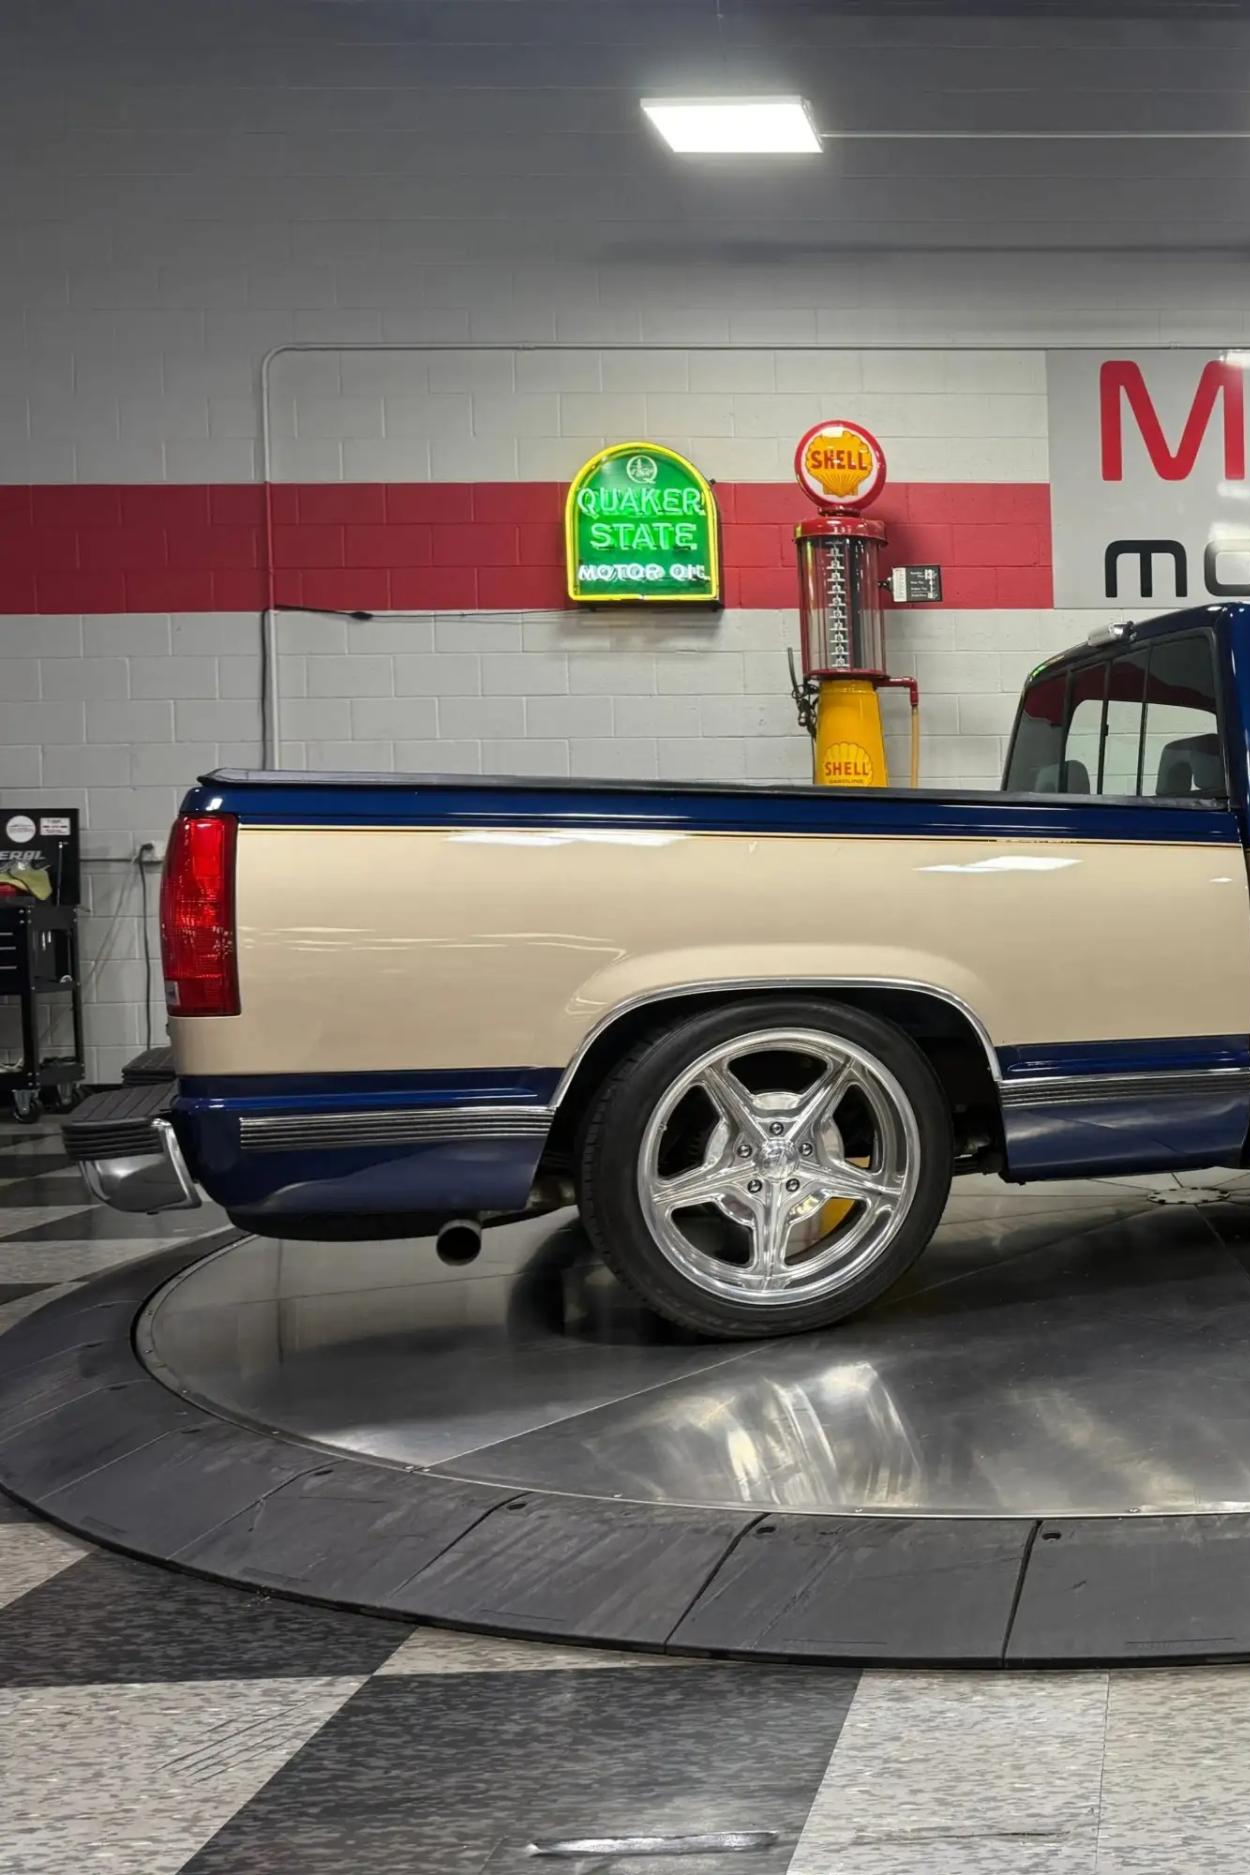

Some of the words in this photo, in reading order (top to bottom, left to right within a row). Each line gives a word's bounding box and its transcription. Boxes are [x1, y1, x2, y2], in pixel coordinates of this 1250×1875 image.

[810, 449, 869, 471] SHELL
[576, 486, 707, 520] QUAKER
[589, 522, 698, 551] STATE
[578, 562, 666, 582] MOTOR
[669, 562, 711, 582] OIL
[824, 761, 869, 777] SHELL
